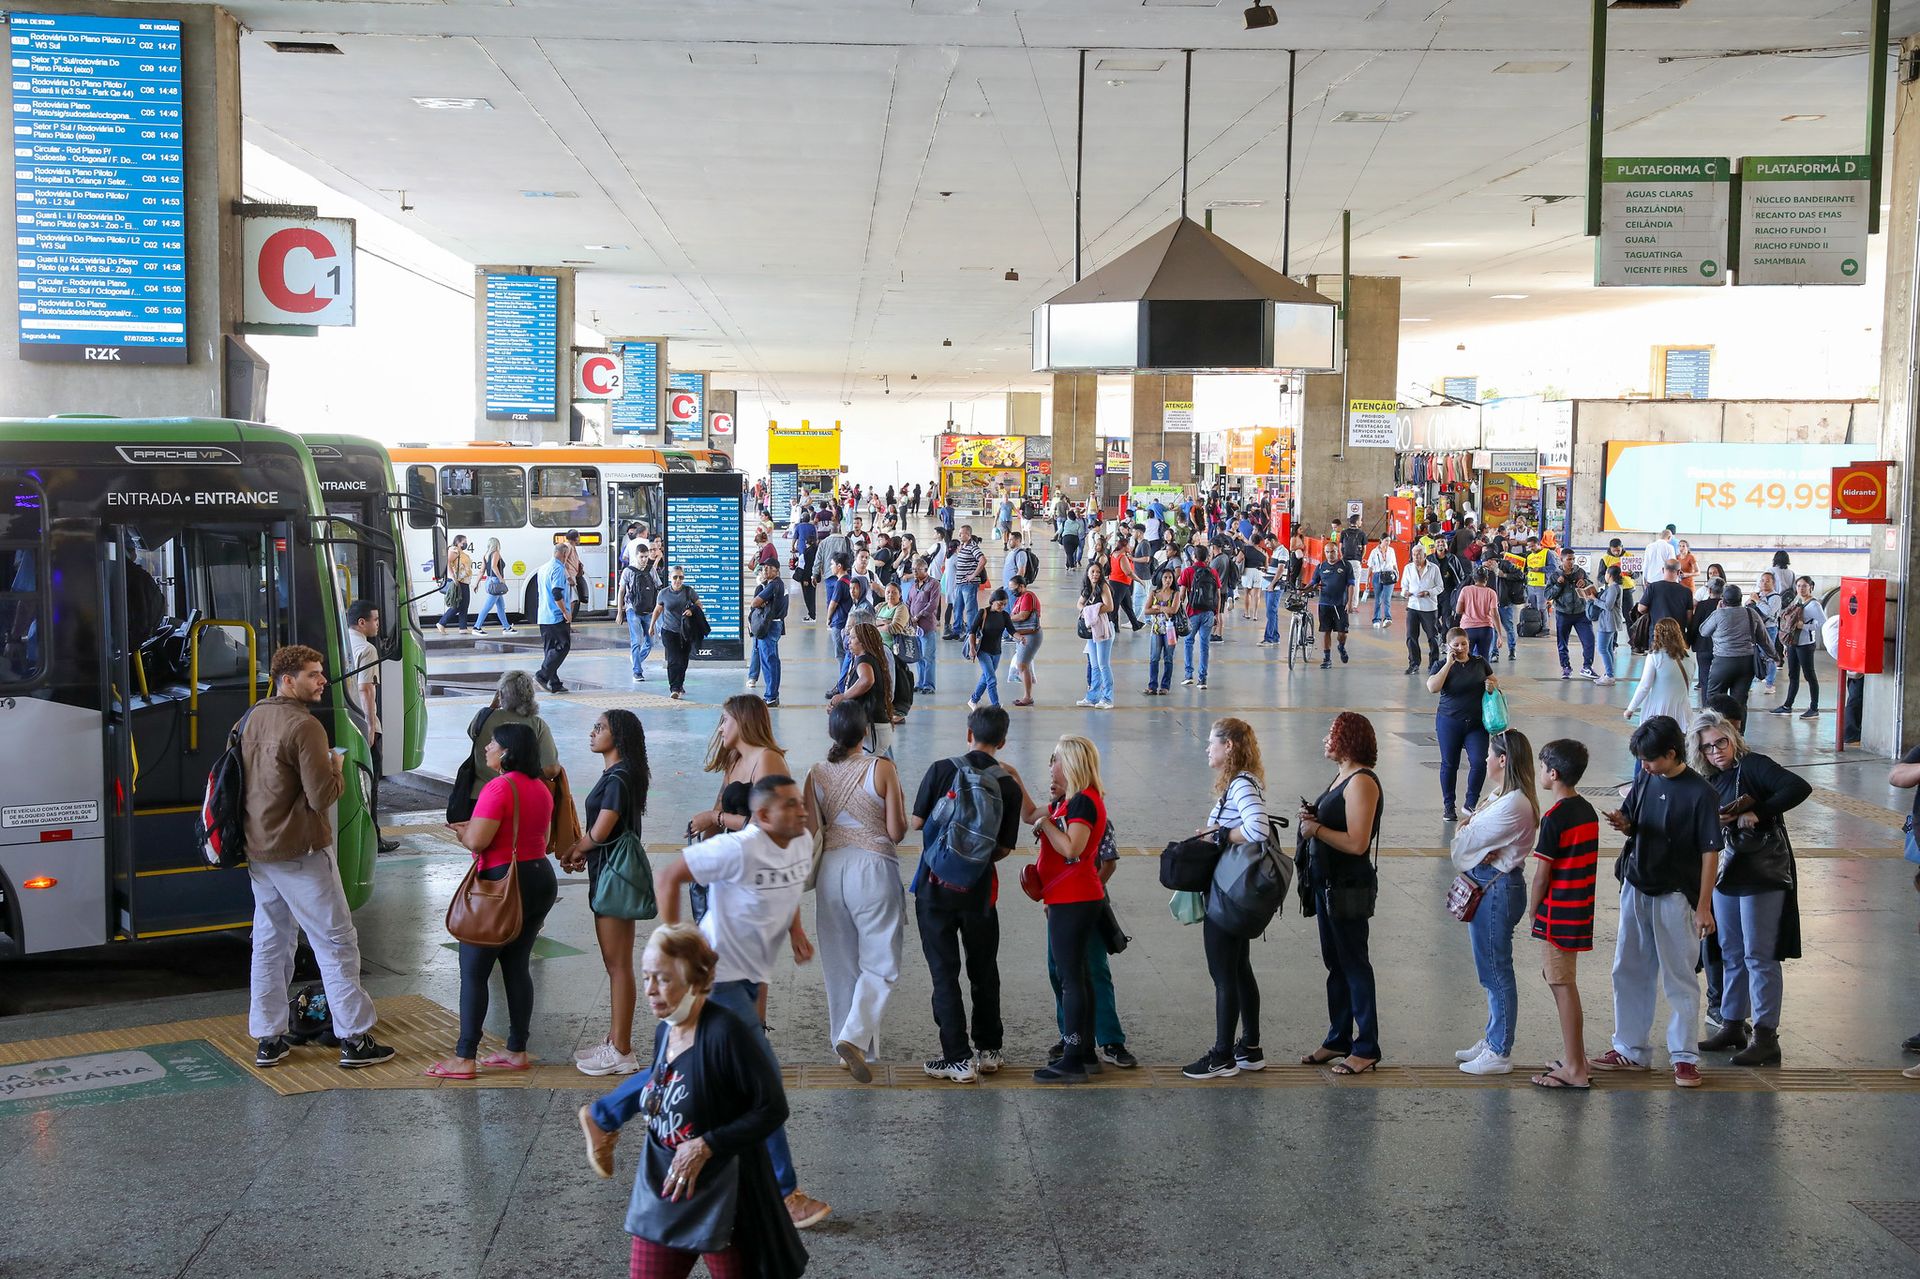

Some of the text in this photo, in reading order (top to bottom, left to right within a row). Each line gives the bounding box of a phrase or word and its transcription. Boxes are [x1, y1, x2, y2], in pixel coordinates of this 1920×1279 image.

[1617, 163, 1715, 176] PLATAFORMA C
[1756, 161, 1856, 174] PLATAFORMA D
[1626, 205, 1683, 213] BRAZLÂNDIA
[1755, 211, 1796, 219] RECANTO
[1625, 219, 1673, 228] CEILÂNDIA
[1755, 226, 1788, 234] RIACHO
[1754, 242, 1787, 250] RIACHO
[1624, 251, 1683, 259] TAGUATINGA
[1754, 257, 1806, 265] SAMAMBAIA
[1624, 266, 1661, 274] VICENTE
[84, 348, 120, 360] RZK
[1352, 402, 1396, 411] ATENÇÃO!
[108, 492, 278, 505] ENTRADA ENTRANCE
[1695, 482, 1737, 510] R$
